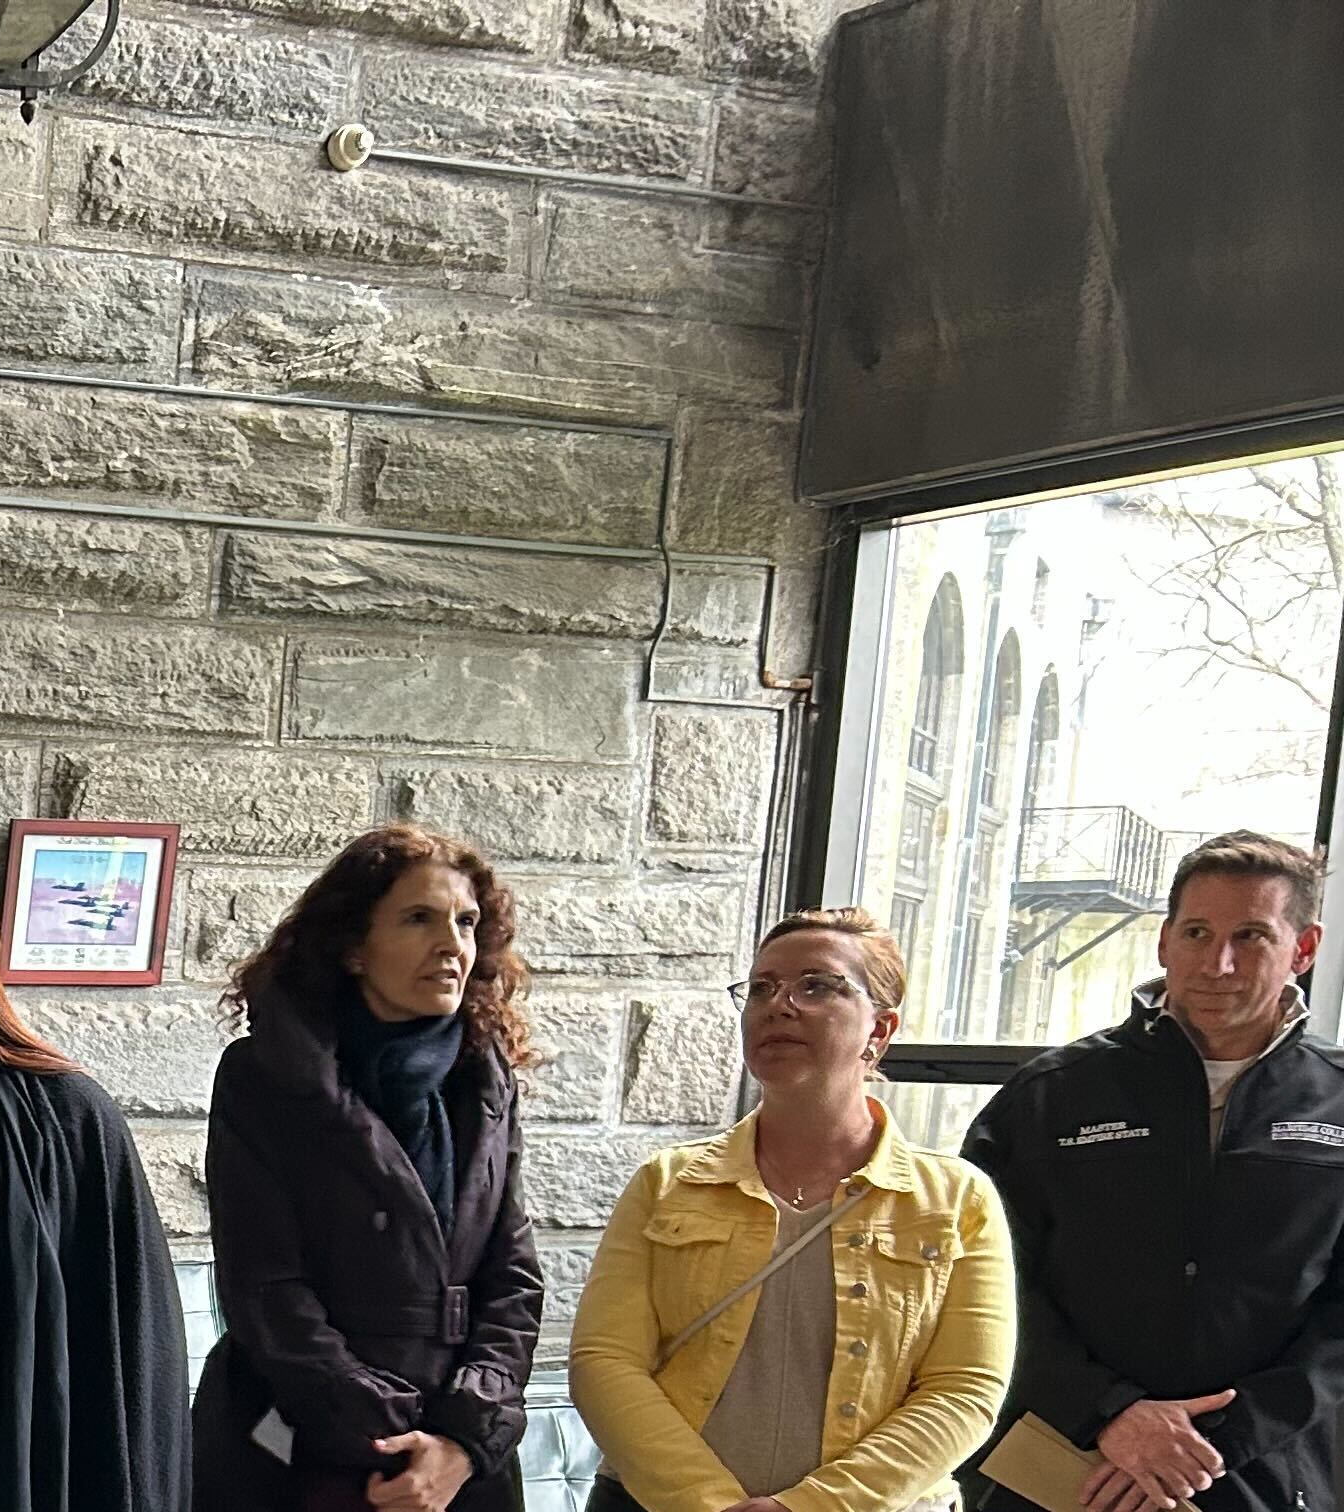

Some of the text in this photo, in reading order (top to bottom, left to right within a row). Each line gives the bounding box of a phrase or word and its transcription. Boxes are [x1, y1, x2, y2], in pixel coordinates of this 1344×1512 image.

[1080, 1122, 1127, 1135] MASTER
[1077, 1132, 1114, 1144] EMPIRE
[1116, 1128, 1150, 1139] STATE
